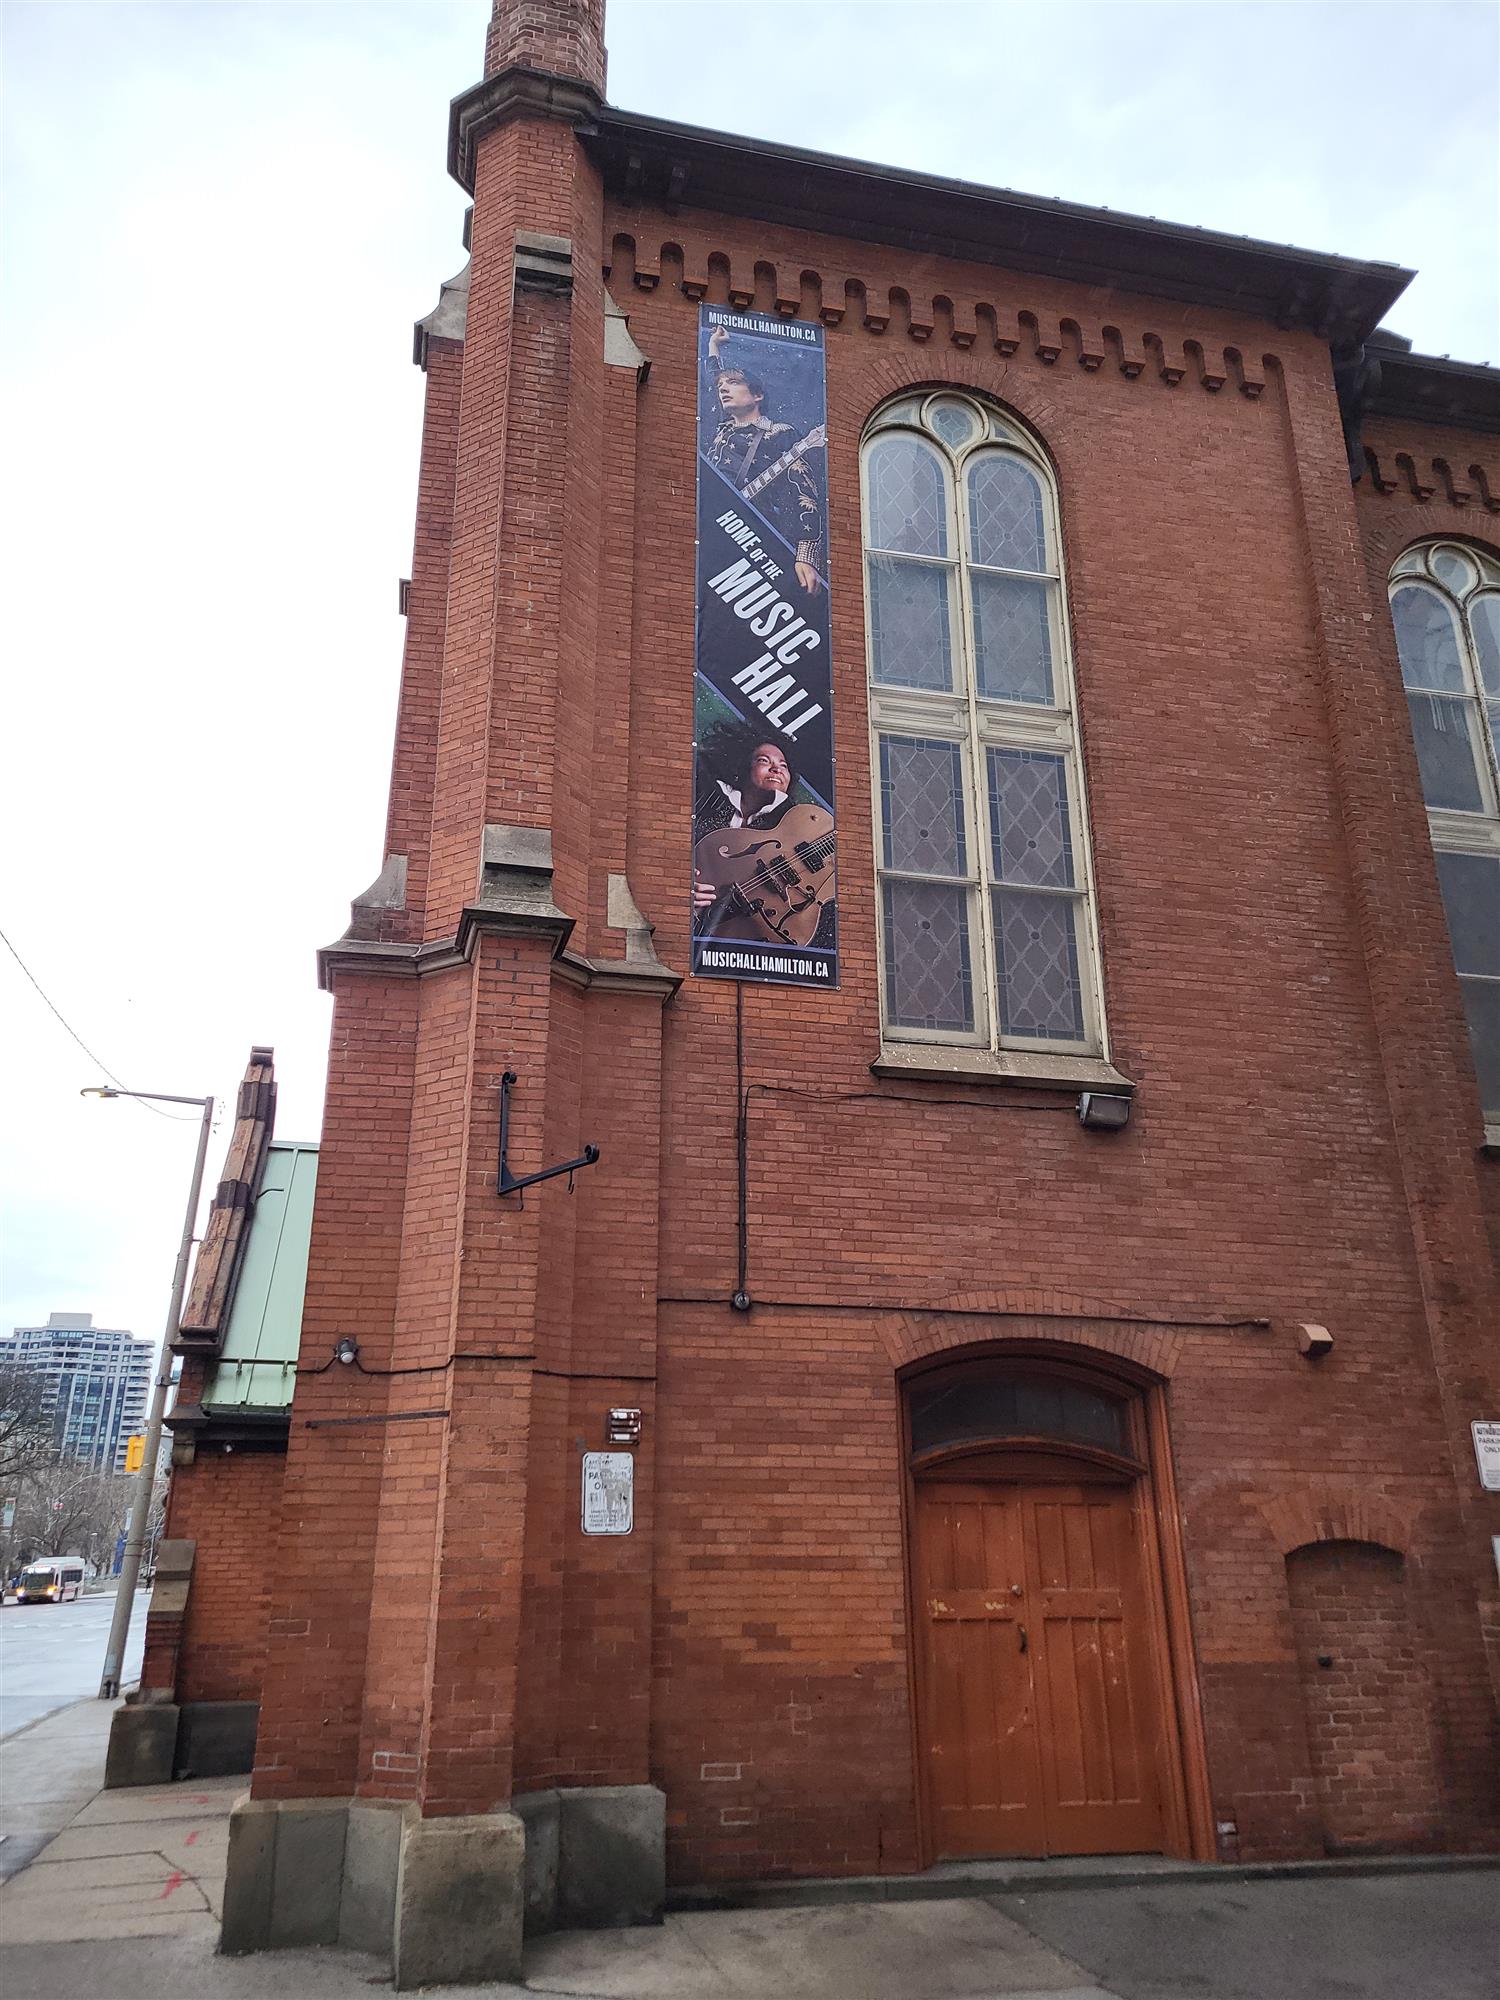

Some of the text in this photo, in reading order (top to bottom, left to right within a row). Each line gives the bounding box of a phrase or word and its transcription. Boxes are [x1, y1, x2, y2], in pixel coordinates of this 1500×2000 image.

[708, 311, 816, 342] MUSICHALLHAMILTON.CA
[715, 509, 784, 581] HOME OF THE
[707, 557, 821, 665] MUSIC
[730, 651, 823, 742] HALL
[702, 950, 829, 977] MUSICHALLHAMILTON.CA
